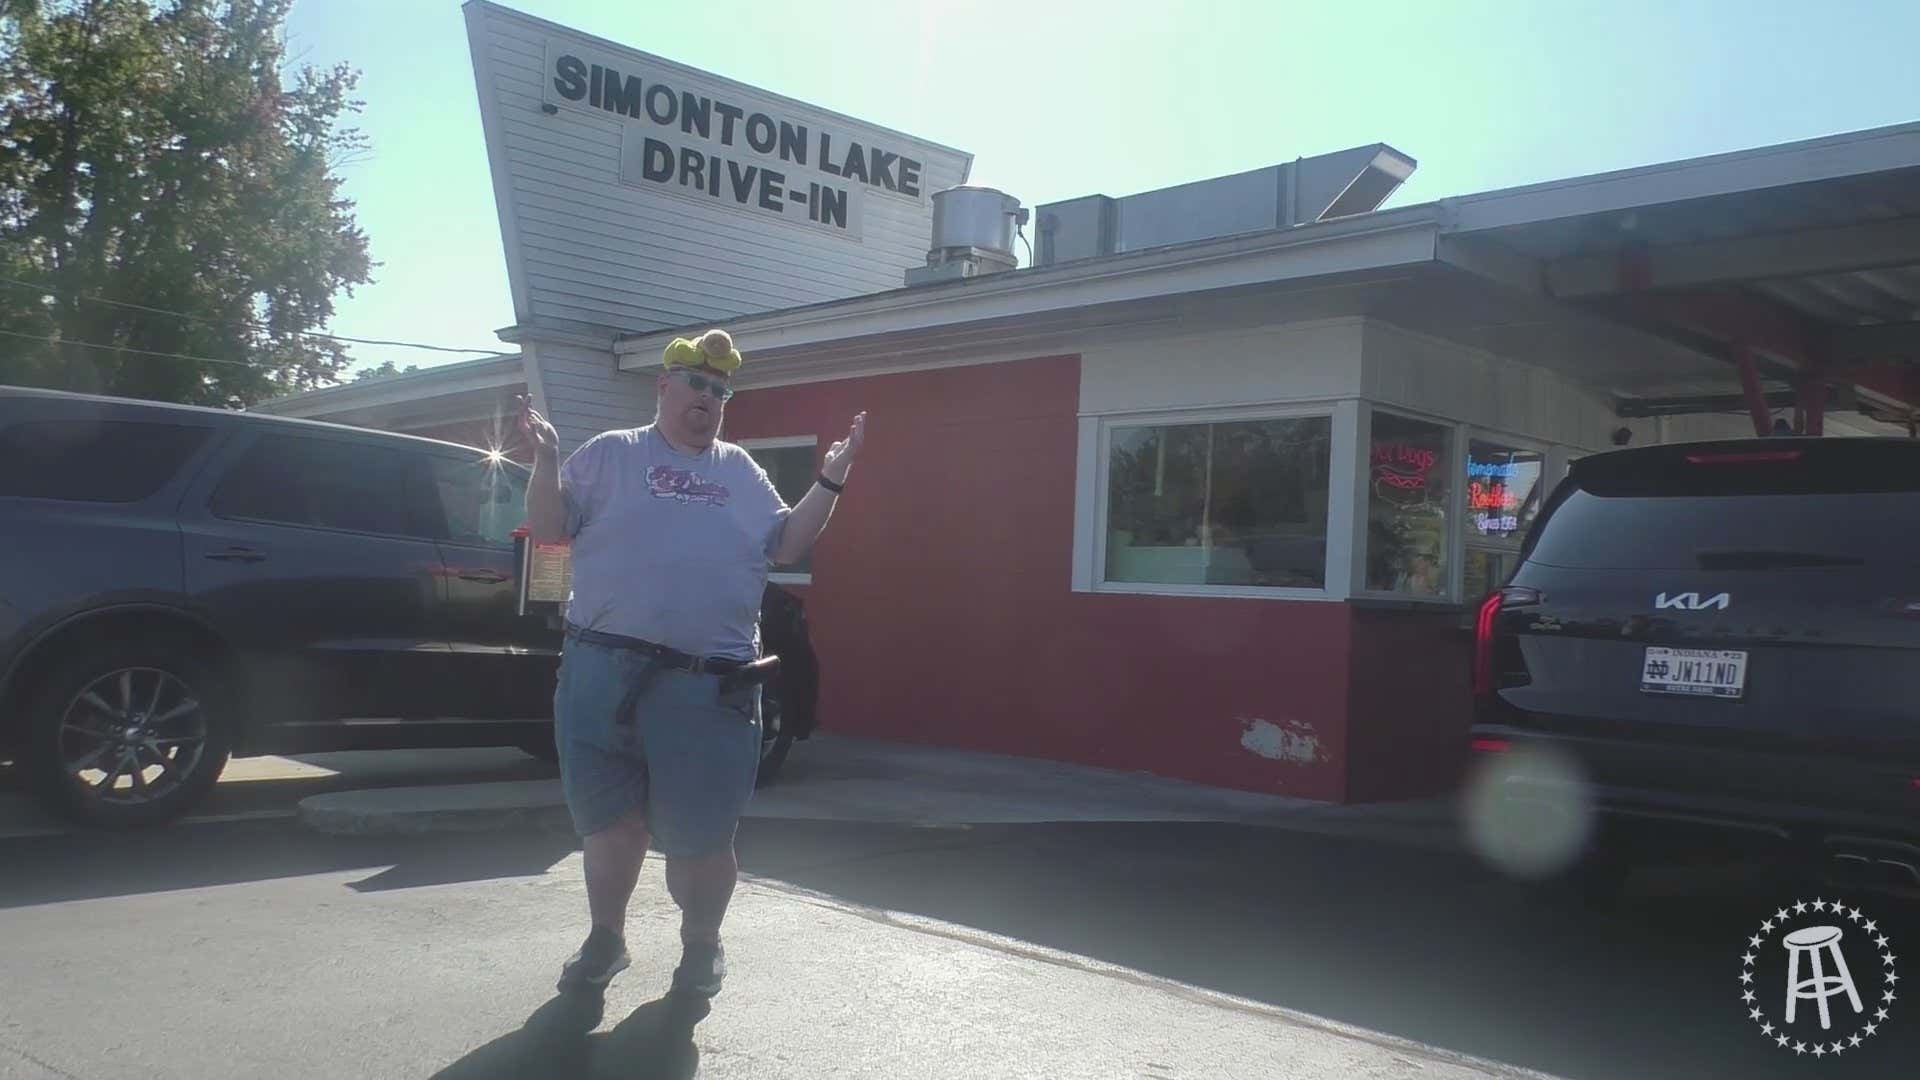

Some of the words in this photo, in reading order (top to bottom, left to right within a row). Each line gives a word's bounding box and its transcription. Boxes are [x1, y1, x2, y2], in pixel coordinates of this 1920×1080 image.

[554, 54, 807, 165] SIMONTON
[819, 133, 922, 197] LAKE
[642, 138, 848, 228] DRIVE-IN
[1656, 592, 1729, 610] KIA
[1672, 648, 1718, 659] INDIANA
[1672, 661, 1737, 685] JW11ND
